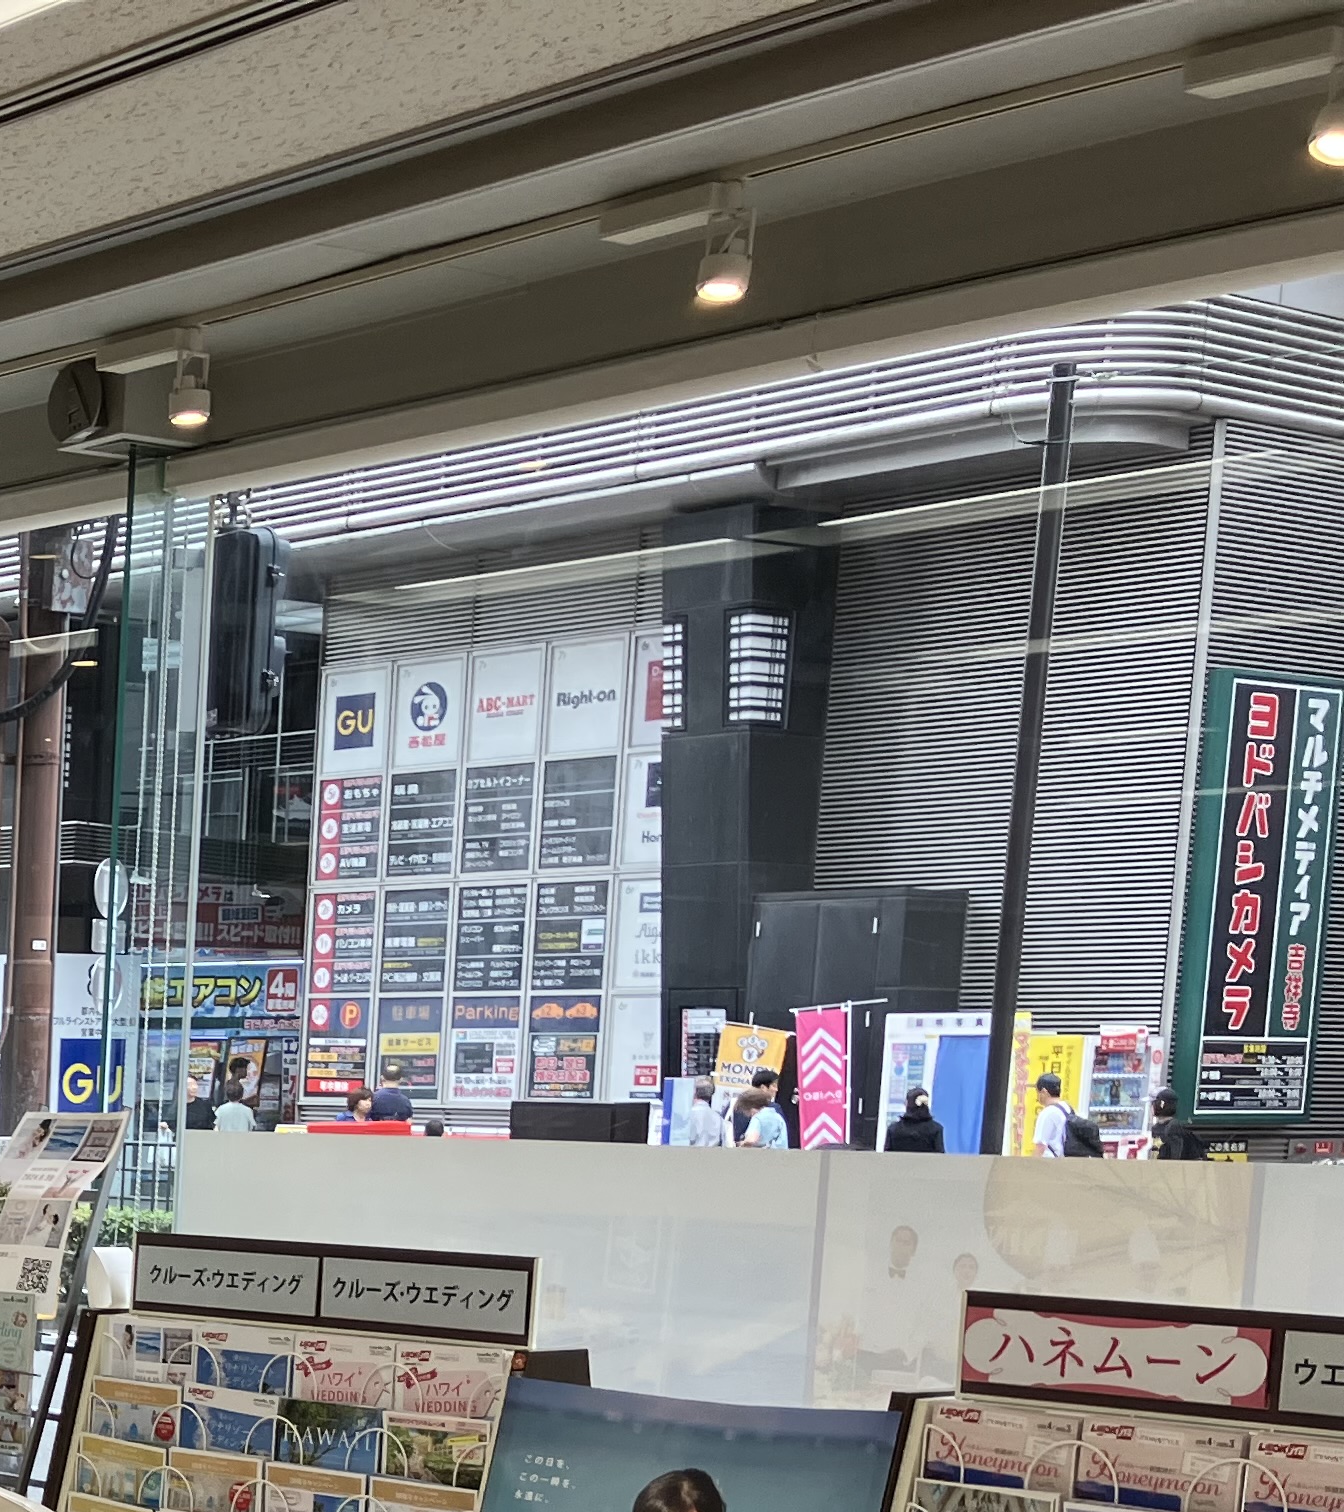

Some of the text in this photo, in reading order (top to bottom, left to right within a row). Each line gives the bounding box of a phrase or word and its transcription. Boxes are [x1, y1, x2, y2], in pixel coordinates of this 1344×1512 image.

[477, 694, 535, 714] ABC-MART
[556, 689, 616, 709] Right-on
[336, 708, 375, 737] GU
[1289, 698, 1330, 936] マルチメディア
[1222, 691, 1280, 1031] ヨドバシカメラ
[634, 949, 662, 965] ikk
[1281, 943, 1306, 1031] 吉祥寺
[454, 1005, 520, 1021] Parking
[62, 1062, 123, 1104] GU
[149, 1263, 305, 1296] クルーズ・ウエディング
[331, 1276, 515, 1313] クルーズ・ウエディング
[989, 1325, 1238, 1385] ハネムーン
[320, 1371, 356, 1388] ハワイ
[426, 1381, 463, 1397] ハワイ
[414, 1399, 478, 1414] WEDDING
[283, 1422, 371, 1452] HAWAII
[935, 1430, 1060, 1479] Honeymoon
[1085, 1448, 1223, 1498] Honeymoon
